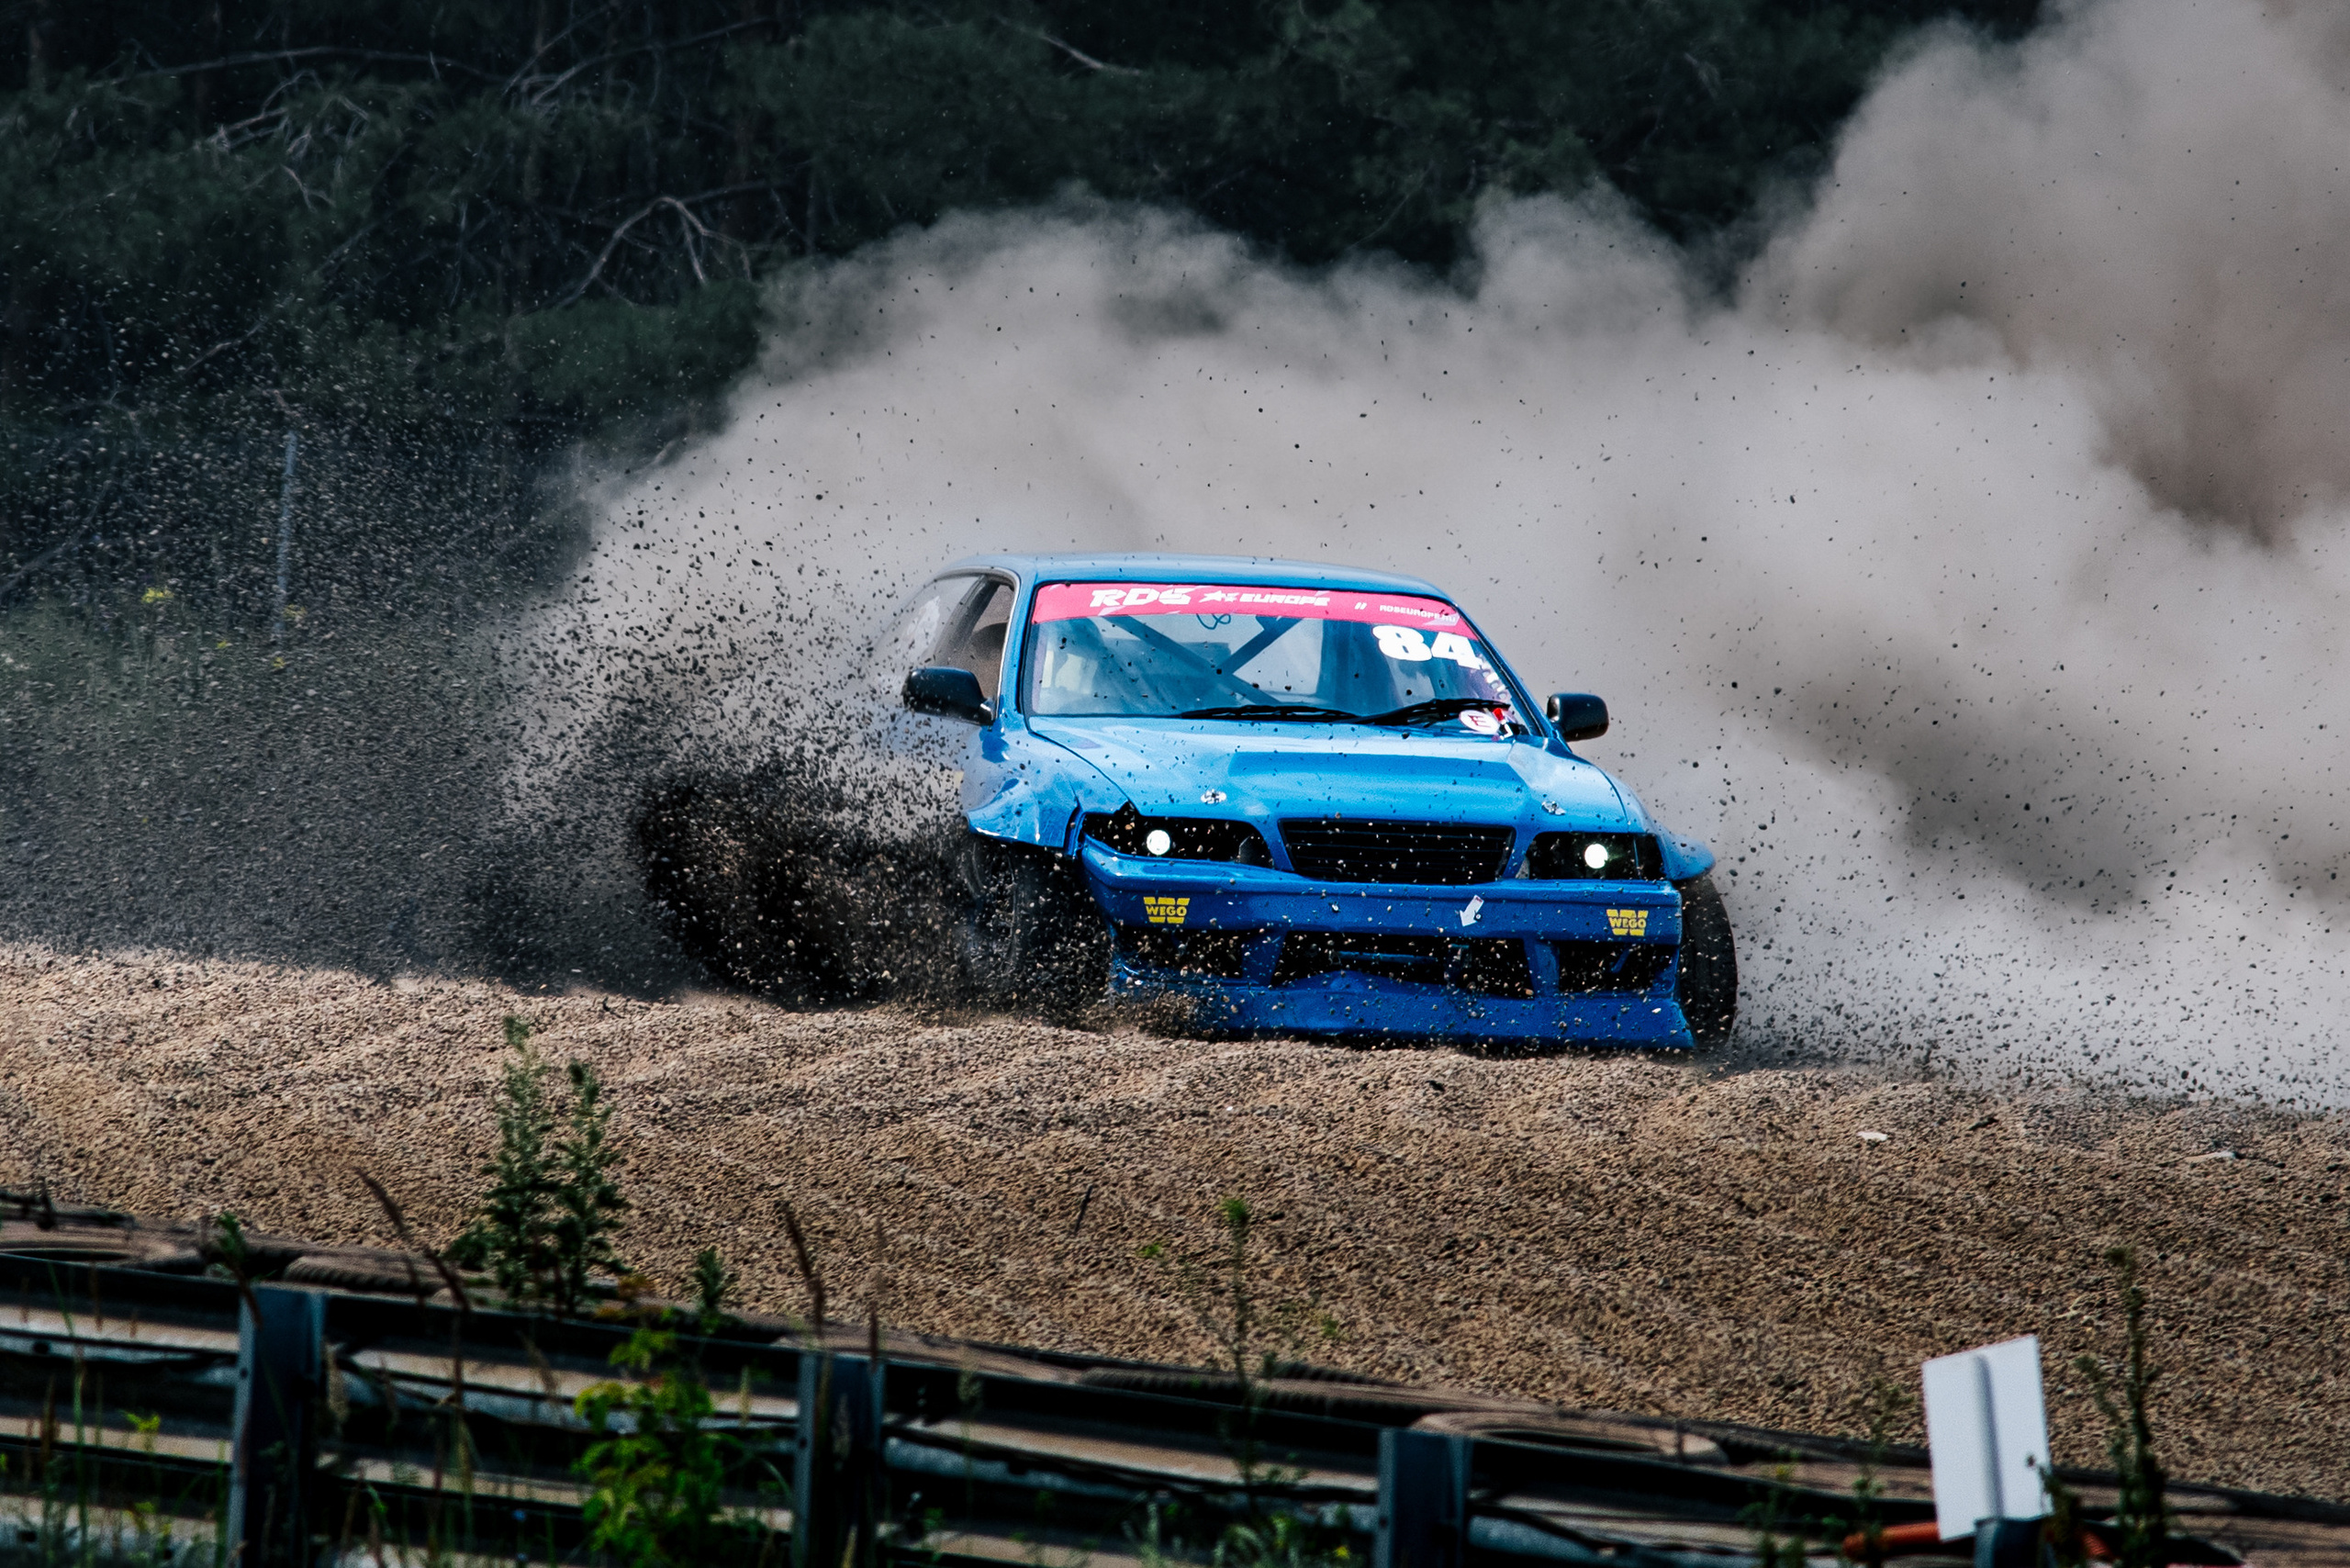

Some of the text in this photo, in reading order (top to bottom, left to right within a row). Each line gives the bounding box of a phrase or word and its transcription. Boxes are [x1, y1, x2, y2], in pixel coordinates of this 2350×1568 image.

[1090, 588, 1192, 608] RDS
[1239, 593, 1331, 607] EUROPE
[1372, 625, 1483, 670] 84
[1146, 905, 1187, 917] WEGO
[1608, 917, 1647, 929] WEGO
